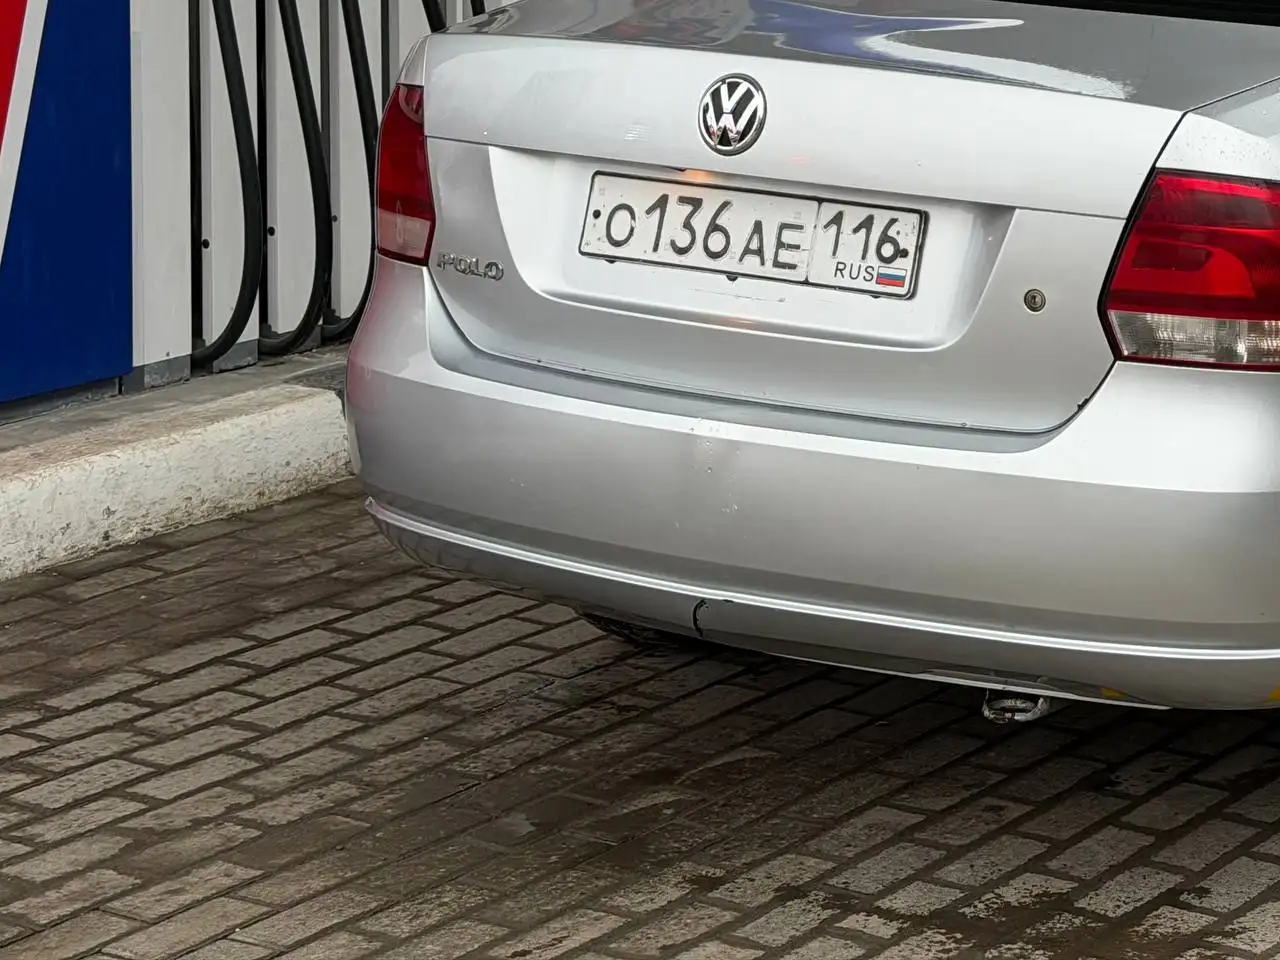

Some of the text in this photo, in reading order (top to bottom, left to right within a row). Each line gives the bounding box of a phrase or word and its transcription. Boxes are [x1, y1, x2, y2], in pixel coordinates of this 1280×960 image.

[605, 193, 900, 271] О136АЕ 116
[437, 251, 504, 282] POLO
[834, 261, 875, 282] RUS
